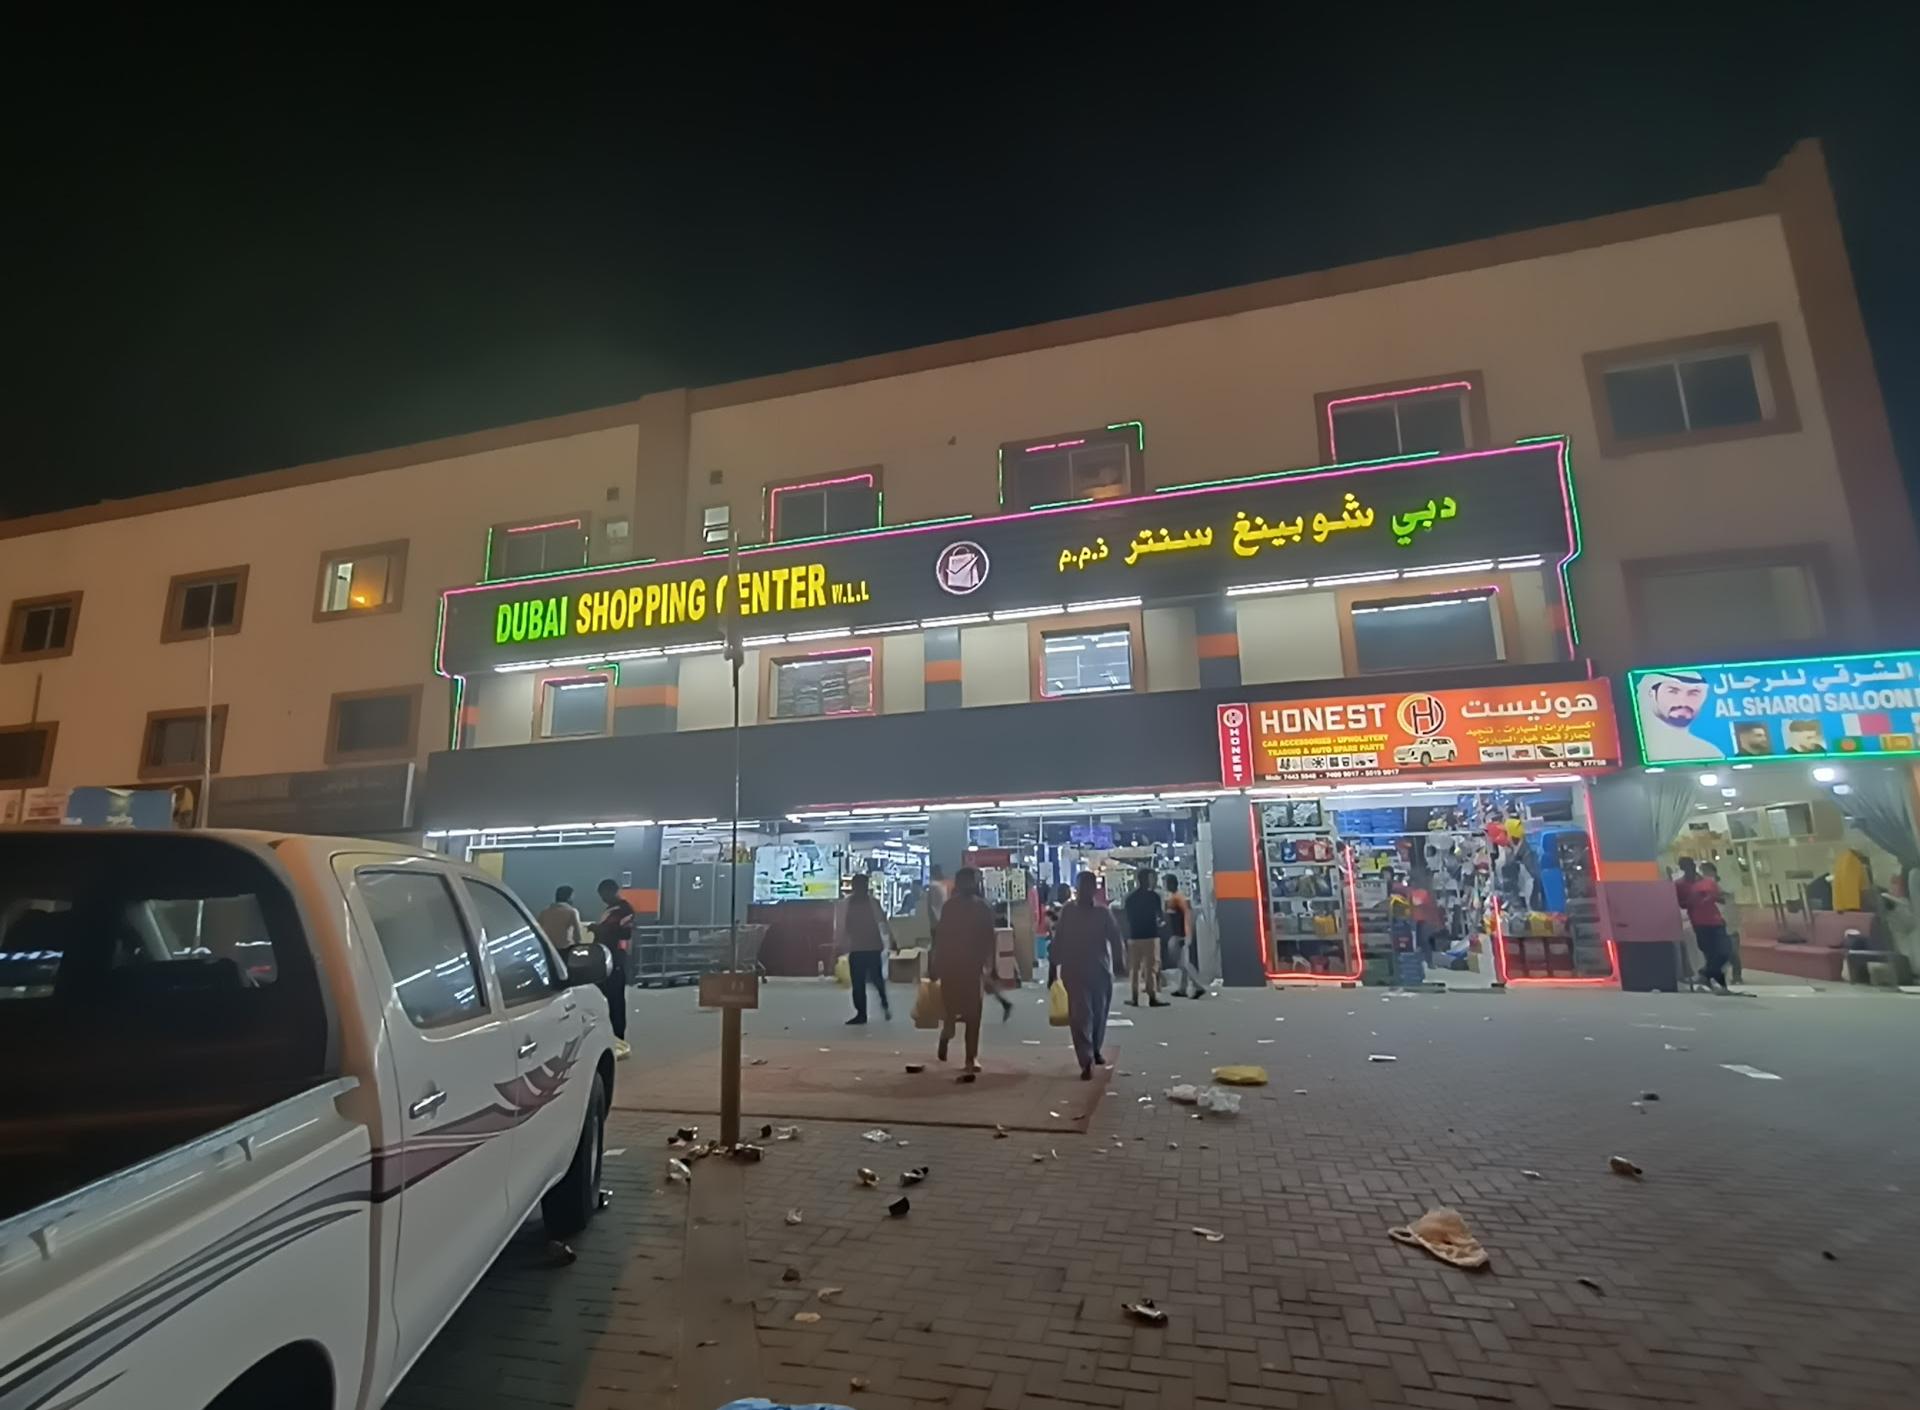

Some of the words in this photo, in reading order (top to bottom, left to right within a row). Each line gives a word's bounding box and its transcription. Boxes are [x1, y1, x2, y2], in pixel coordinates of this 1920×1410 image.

[1392, 496, 1457, 545] دبي
[1124, 527, 1213, 565] سنتر
[496, 596, 568, 643] DUBAI
[576, 578, 706, 634] SHOPPING
[1713, 668, 1806, 694] للرجال
[1812, 660, 1913, 692] الشرقي
[1460, 690, 1598, 721] هونيست
[1715, 698, 1741, 717] AL
[1743, 693, 1822, 716] SHARQI
[1824, 688, 1913, 711] SALOON
[1260, 703, 1386, 734] HONEST
[1229, 728, 1243, 782] HONEST
[1262, 739, 1278, 748] CAR
[1311, 745, 1332, 754] AUTO
